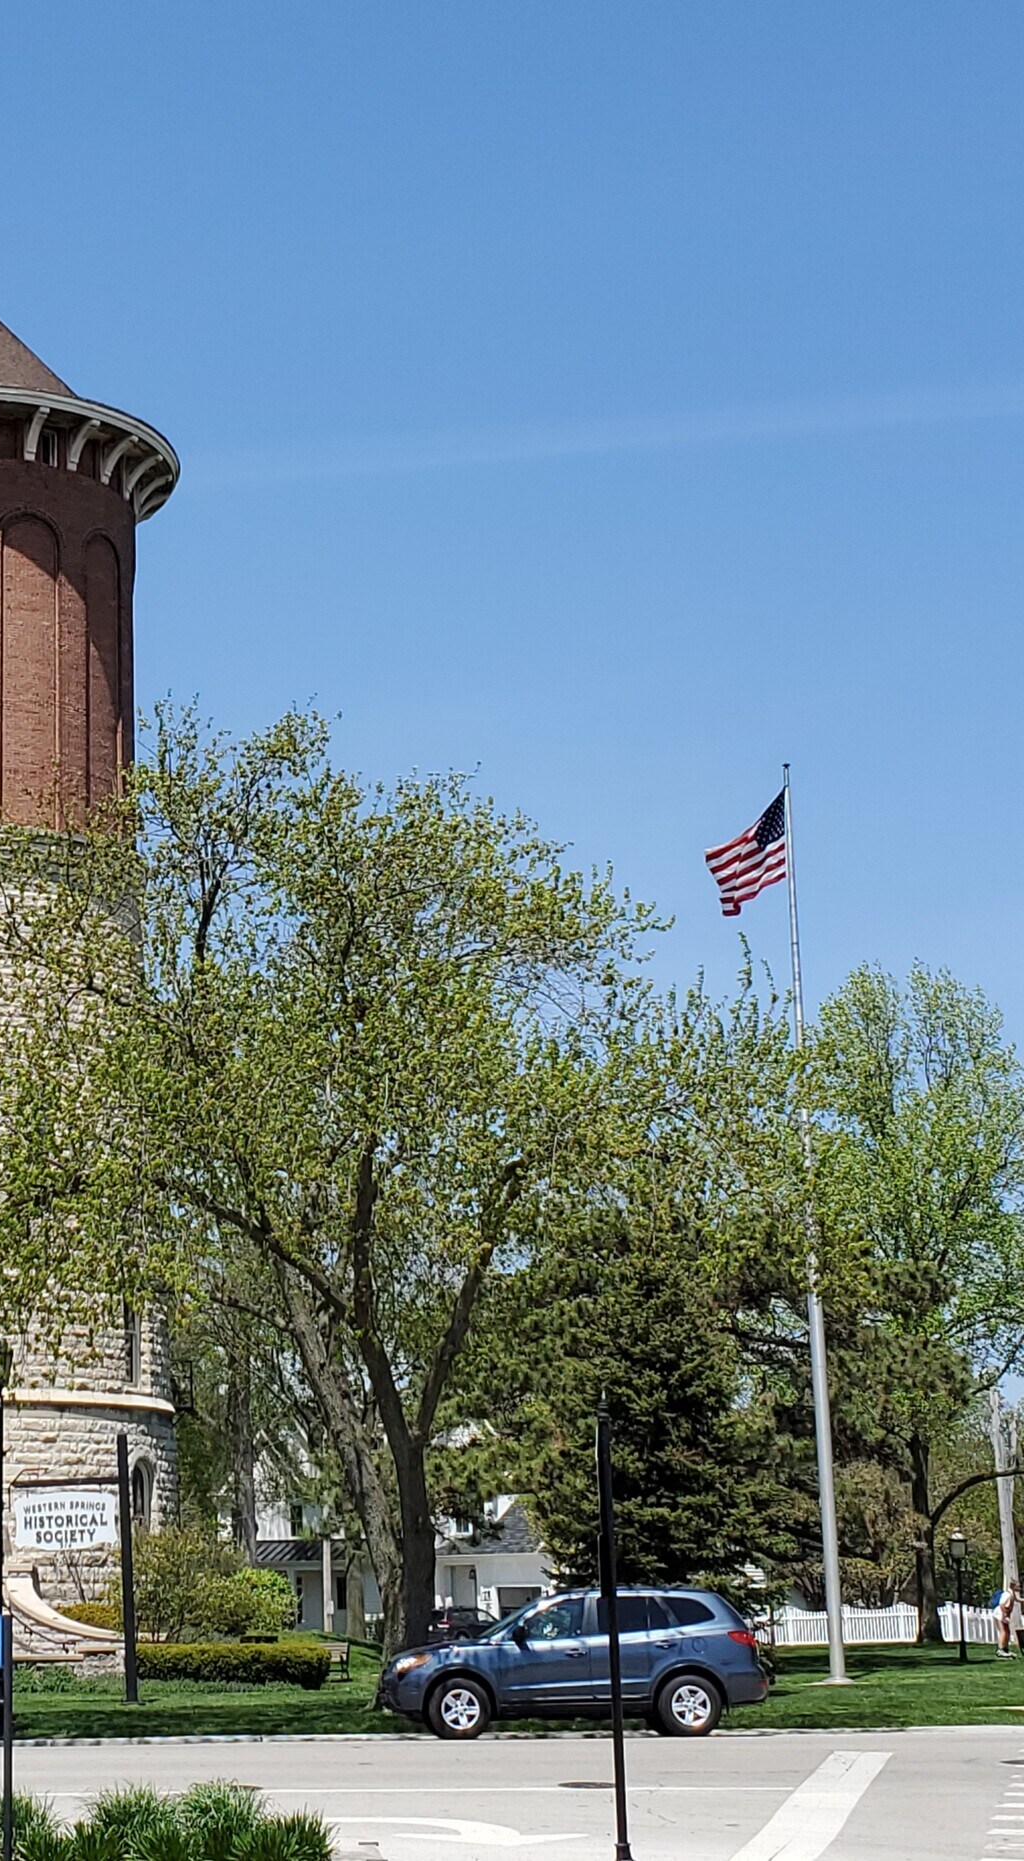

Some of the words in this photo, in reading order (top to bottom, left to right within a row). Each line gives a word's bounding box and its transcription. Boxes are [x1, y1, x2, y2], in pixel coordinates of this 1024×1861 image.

[23, 1501, 66, 1514] WESTERN
[69, 1501, 106, 1511] SPRINGS
[24, 1513, 108, 1530] HISTORICAL
[36, 1528, 96, 1544] SOCIETY
